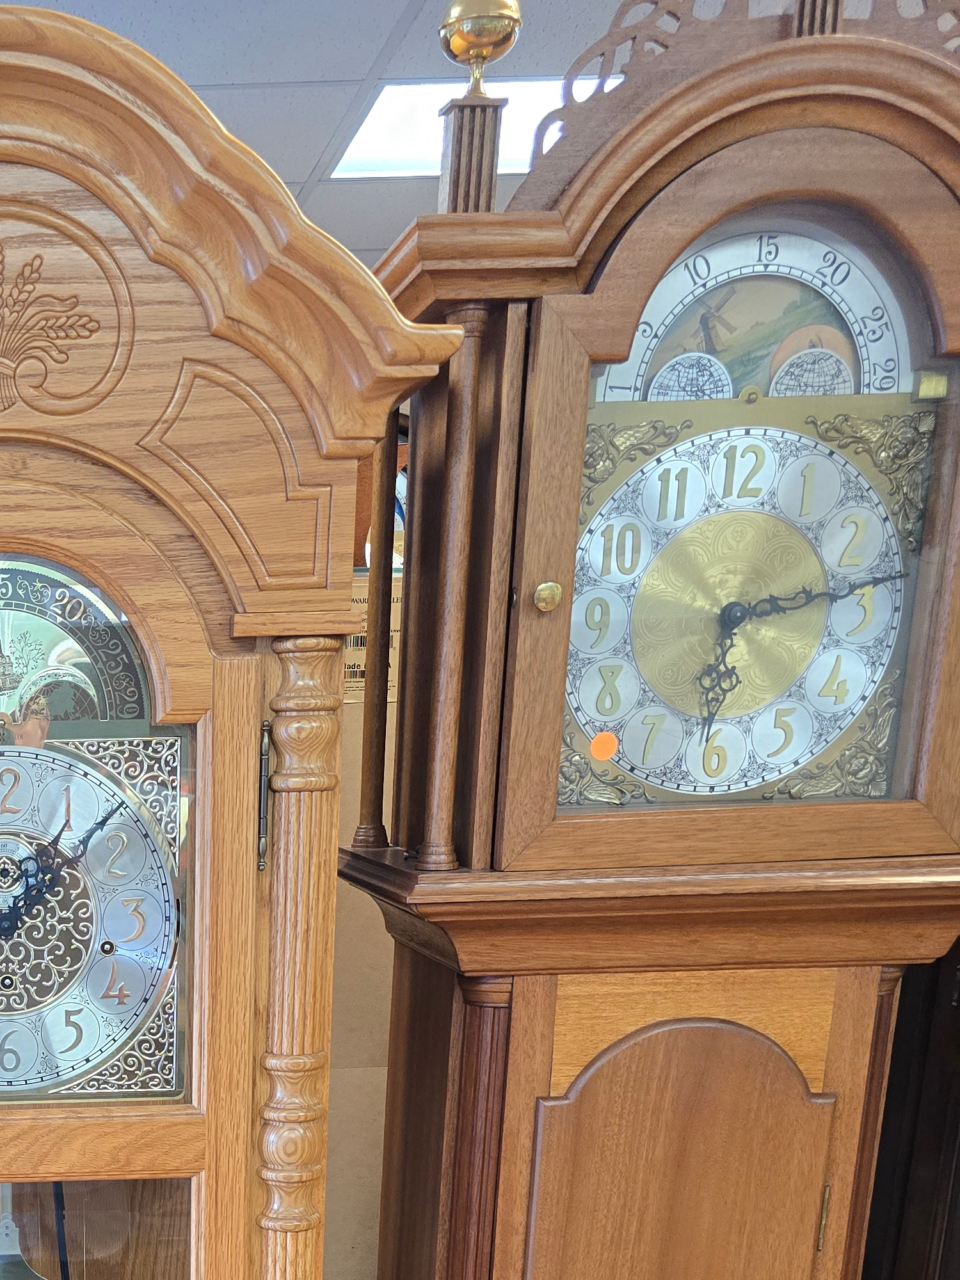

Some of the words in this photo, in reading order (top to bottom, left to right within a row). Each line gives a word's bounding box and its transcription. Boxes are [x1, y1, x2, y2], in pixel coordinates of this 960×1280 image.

[684, 254, 711, 287] 10
[756, 234, 779, 263] 15
[815, 250, 851, 287] 20
[860, 306, 890, 343] 25
[608, 384, 632, 393] 1
[872, 358, 896, 392] 29
[656, 467, 688, 522] 11
[721, 444, 766, 500] 12
[799, 462, 815, 518] 1
[600, 522, 641, 577] 10
[838, 513, 868, 568] 2
[50, 588, 84, 621] 20
[585, 596, 610, 649] 9
[846, 585, 876, 637] 3
[101, 639, 129, 674] 25
[818, 654, 850, 705] 4
[115, 687, 139, 718] 29
[596, 664, 623, 716] 8
[642, 714, 667, 765] 7
[703, 728, 728, 778] 6
[767, 708, 797, 758] 5
[62, 784, 73, 832] 1
[105, 831, 128, 879] 2
[119, 897, 145, 943] 3
[101, 959, 131, 1006] 4
[58, 1007, 84, 1055] 5
